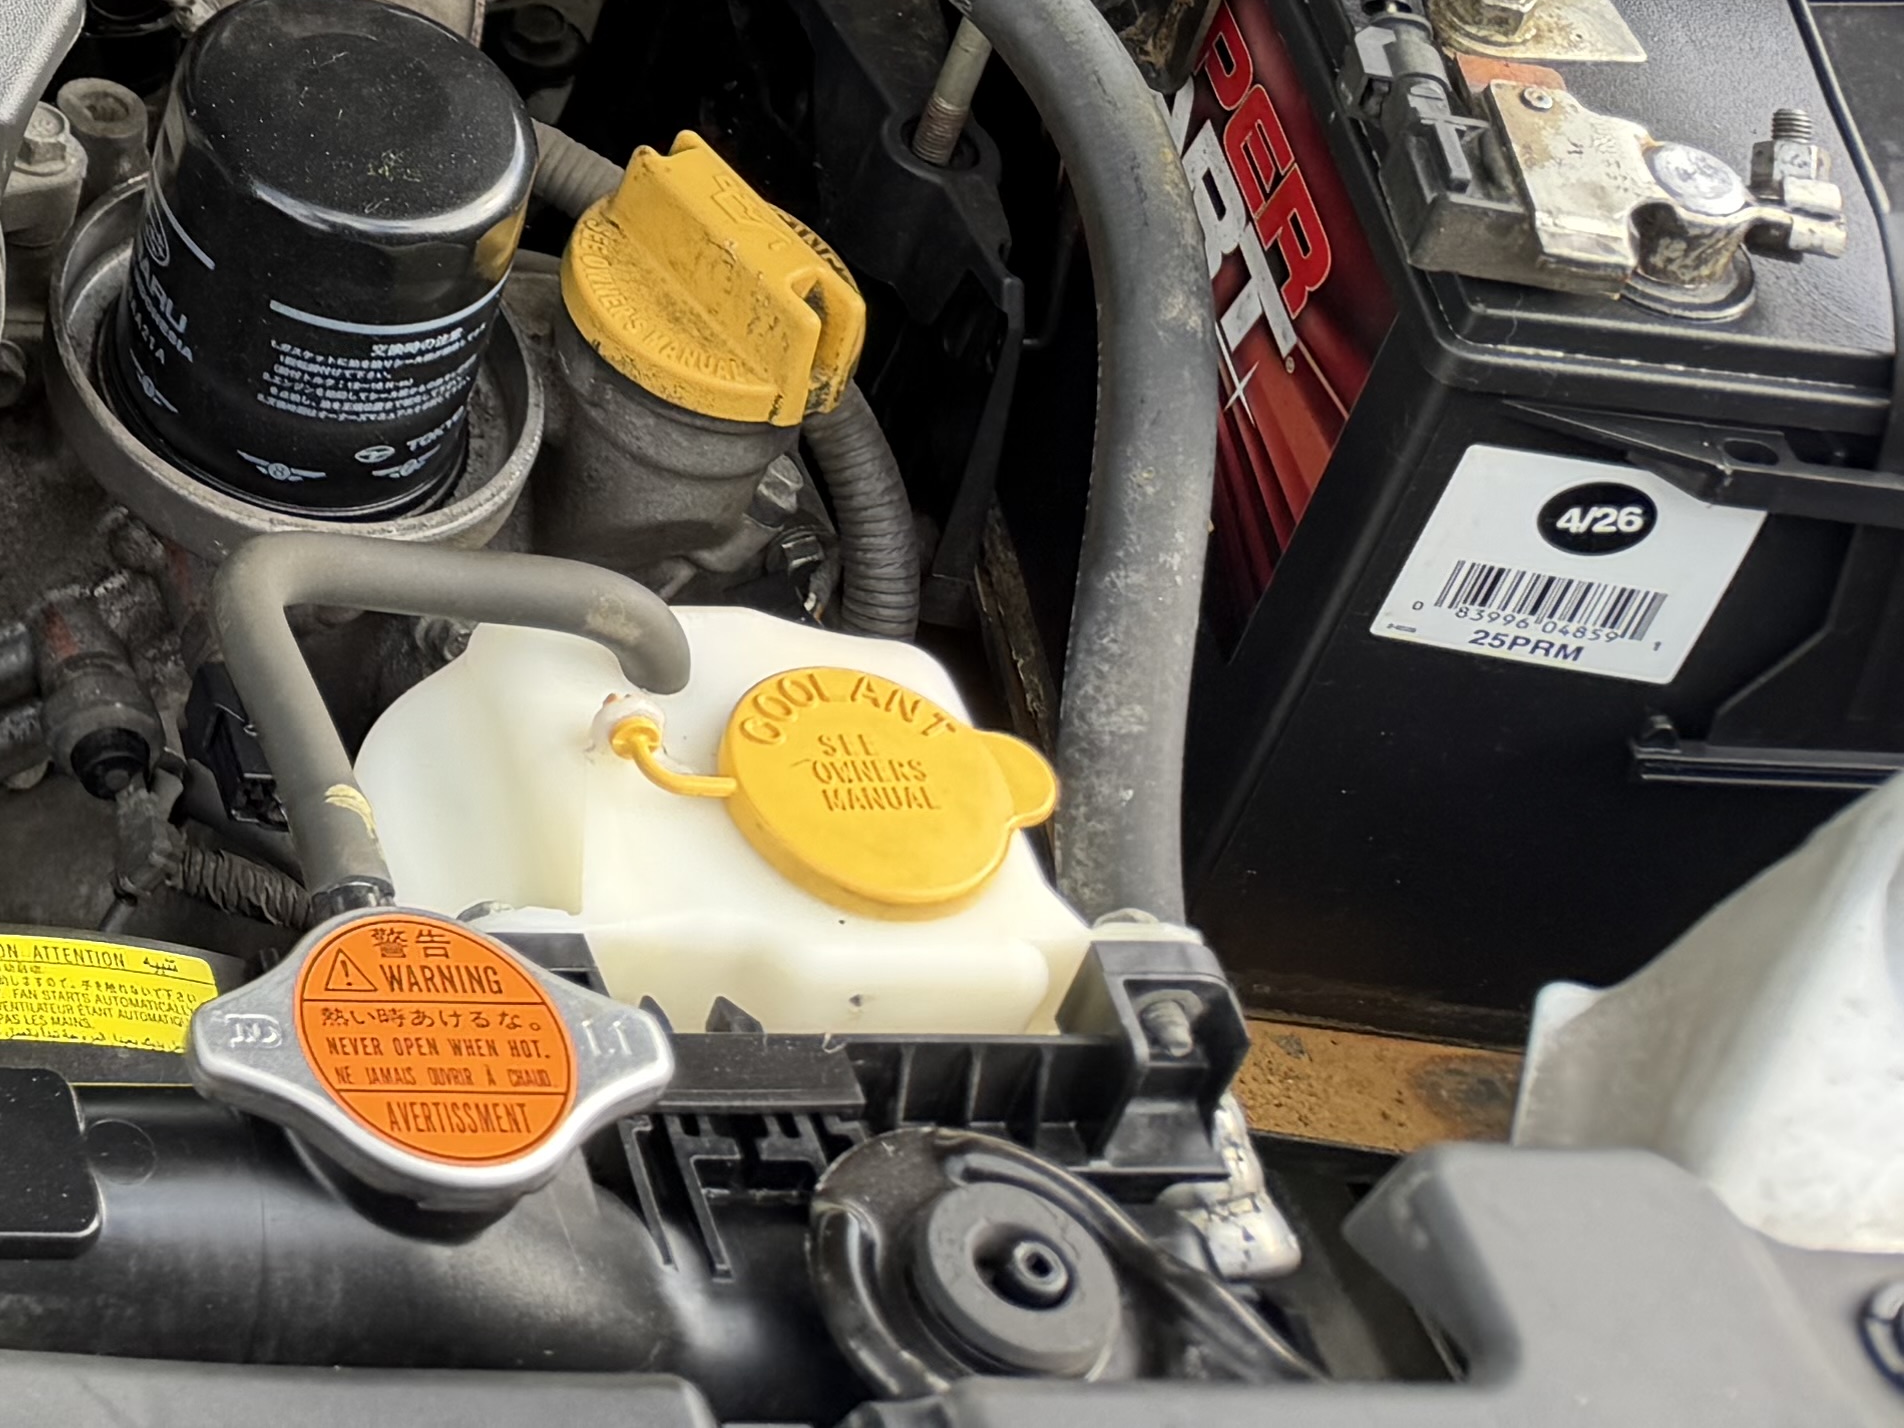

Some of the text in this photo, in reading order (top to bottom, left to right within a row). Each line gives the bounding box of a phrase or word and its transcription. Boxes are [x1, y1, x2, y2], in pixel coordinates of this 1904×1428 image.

[1555, 504, 1646, 535] 4/26
[1468, 629, 1585, 662] 25PRM
[739, 673, 957, 746] COOLANT
[818, 733, 879, 757] SEE
[811, 758, 928, 785] OWNERS
[822, 786, 942, 812] MANUAL
[33, 944, 126, 968] ATTENTION
[371, 927, 452, 960] 警告
[379, 964, 503, 996] WARNING
[13, 989, 38, 1001] FAN
[42, 989, 92, 1004] STARTS
[117, 1008, 190, 1027] AUTOMATIQ
[327, 1037, 550, 1060] NEVER OPEN WHEN HOT.
[335, 1066, 351, 1085] NE
[366, 1066, 418, 1087] JAMAIS
[428, 1067, 476, 1087] OUVRIR
[385, 1100, 534, 1135] AVERTISSMENT
